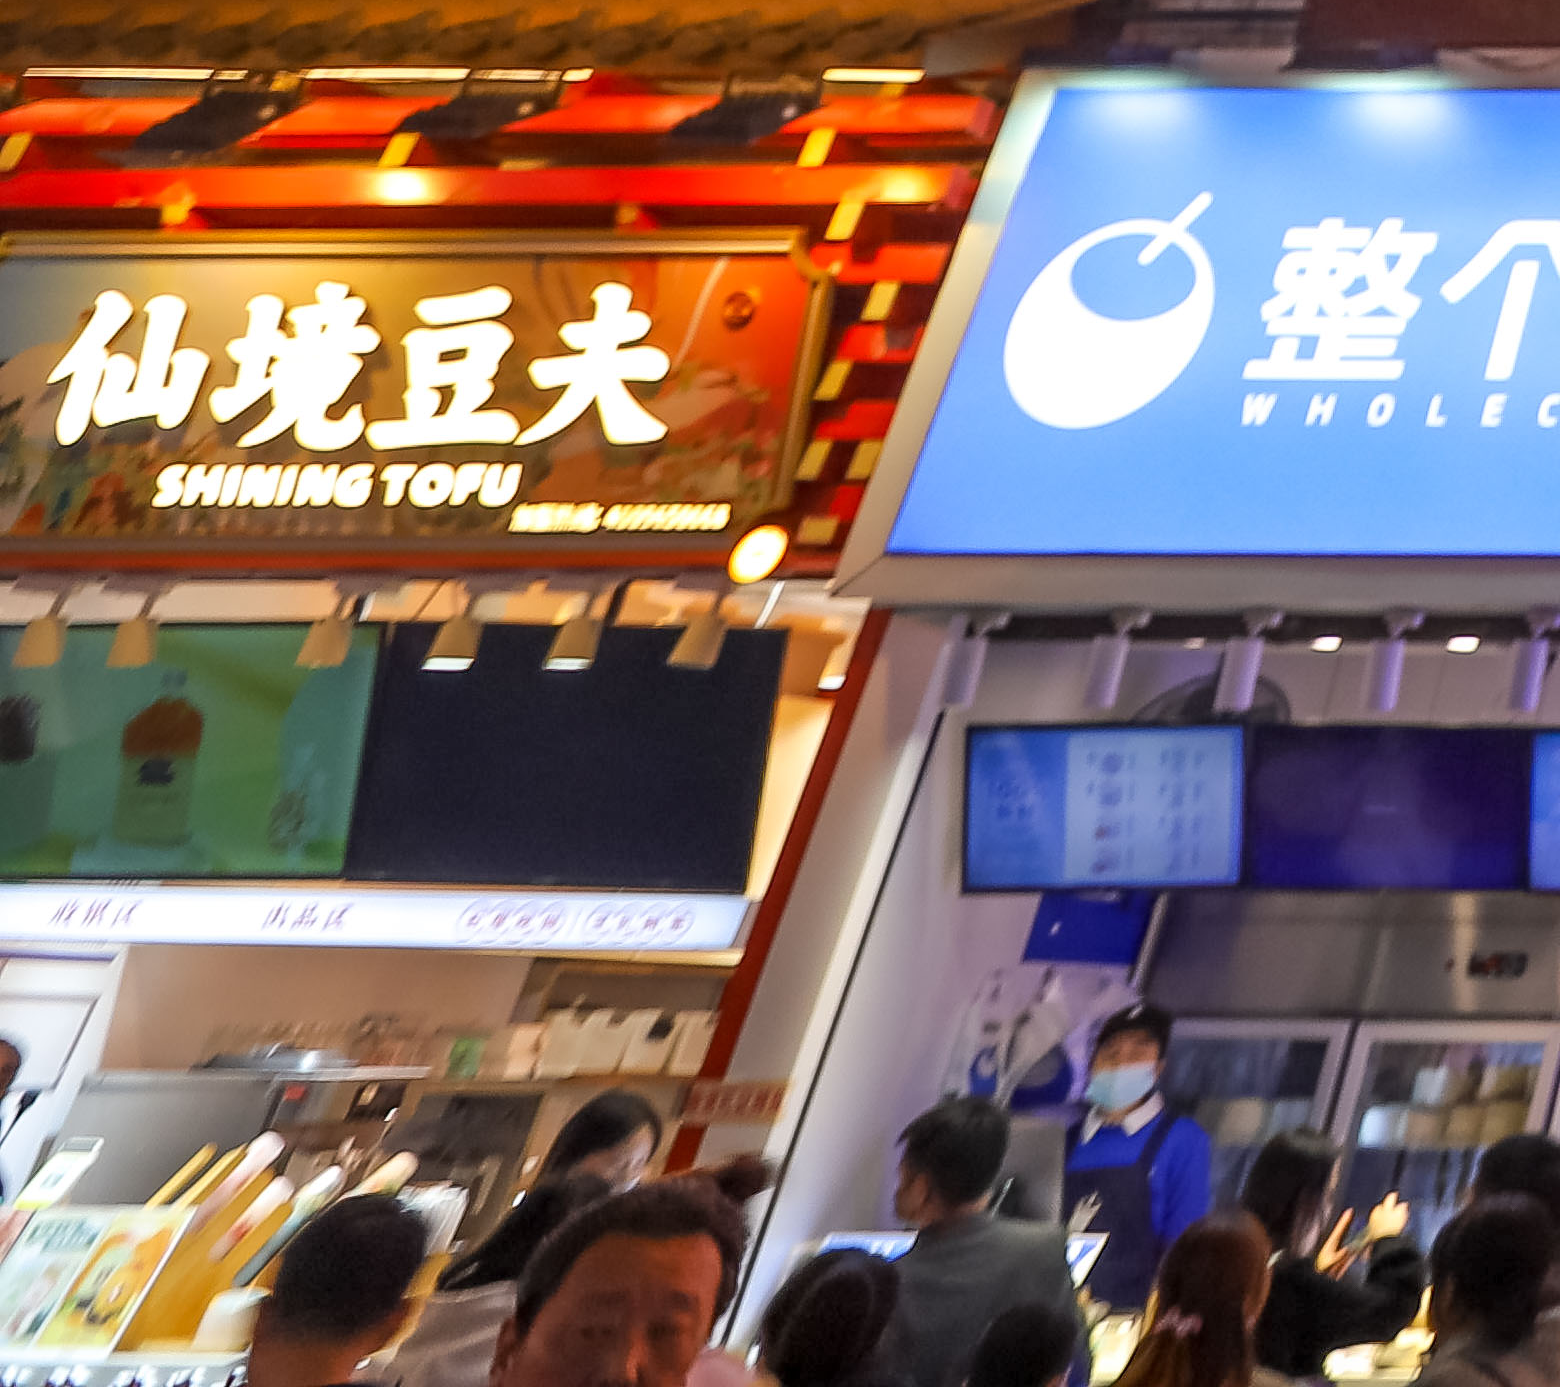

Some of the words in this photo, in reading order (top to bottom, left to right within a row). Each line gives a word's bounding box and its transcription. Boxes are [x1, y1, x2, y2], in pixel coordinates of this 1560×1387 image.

[47, 281, 671, 453] 仙境豆夫
[152, 463, 374, 510] SHINING
[380, 463, 522, 507] TOFU
